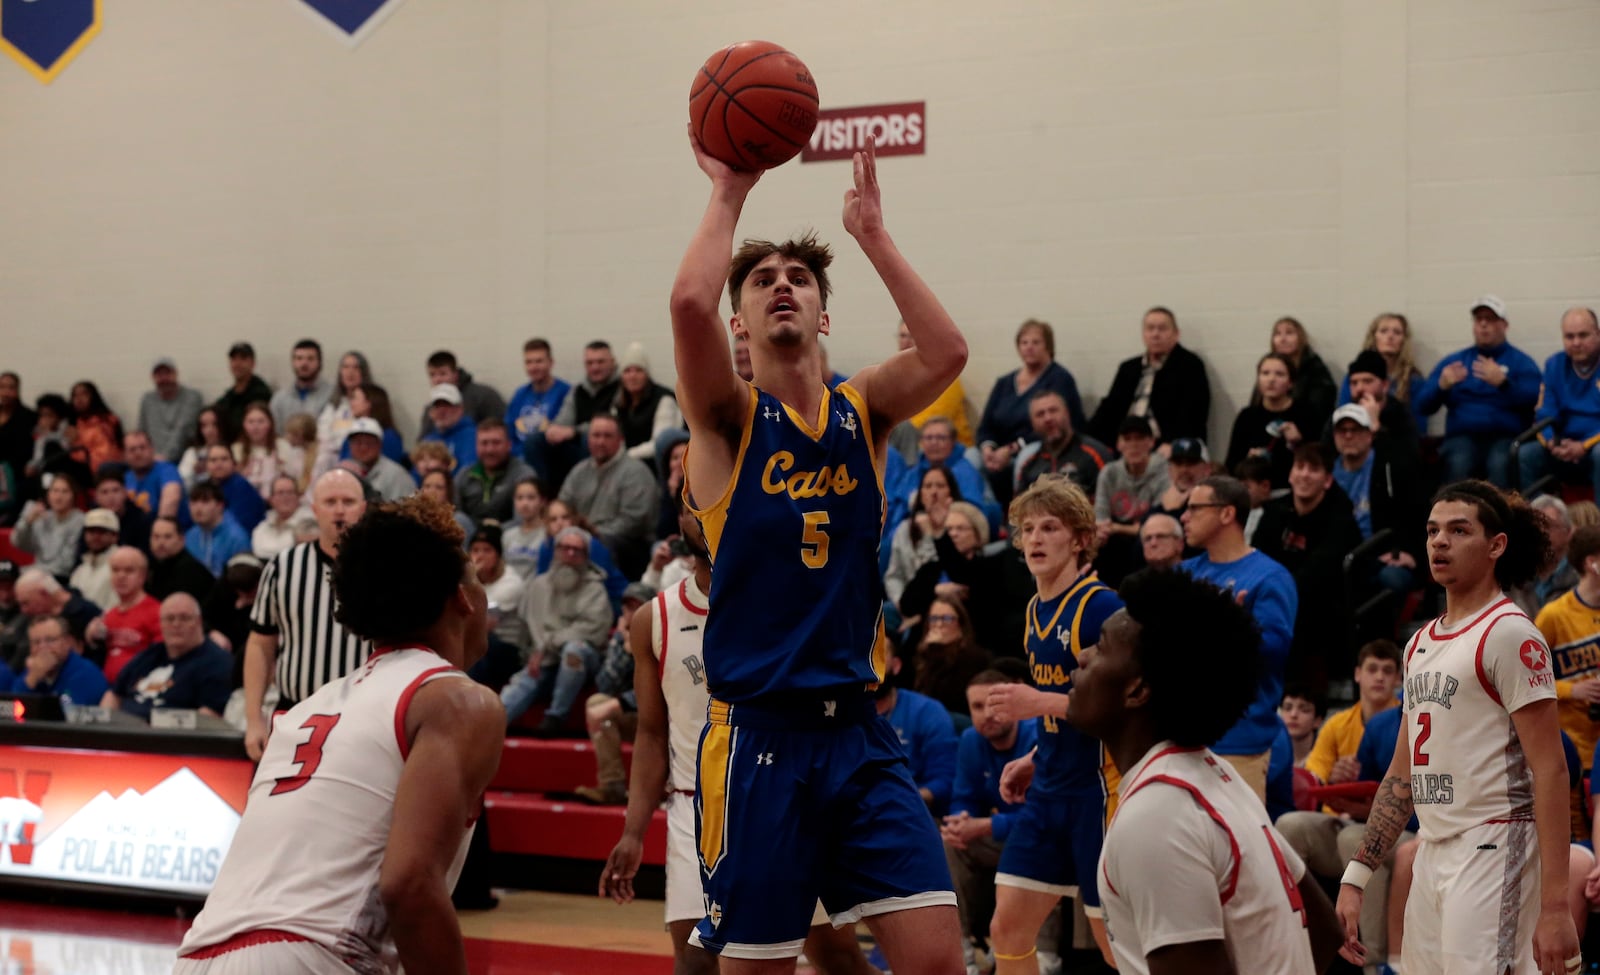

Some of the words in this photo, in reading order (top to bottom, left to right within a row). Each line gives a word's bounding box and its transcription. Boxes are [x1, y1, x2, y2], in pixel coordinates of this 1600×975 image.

[809, 113, 922, 150] VISITORS
[801, 511, 830, 568] 5
[1556, 643, 1600, 675] LEH
[1406, 671, 1459, 711] POLAR
[269, 712, 342, 797] 3
[1413, 712, 1431, 766] 2
[1410, 773, 1454, 804] EARS
[59, 836, 135, 877] POLAR
[139, 843, 220, 885] BEARS
